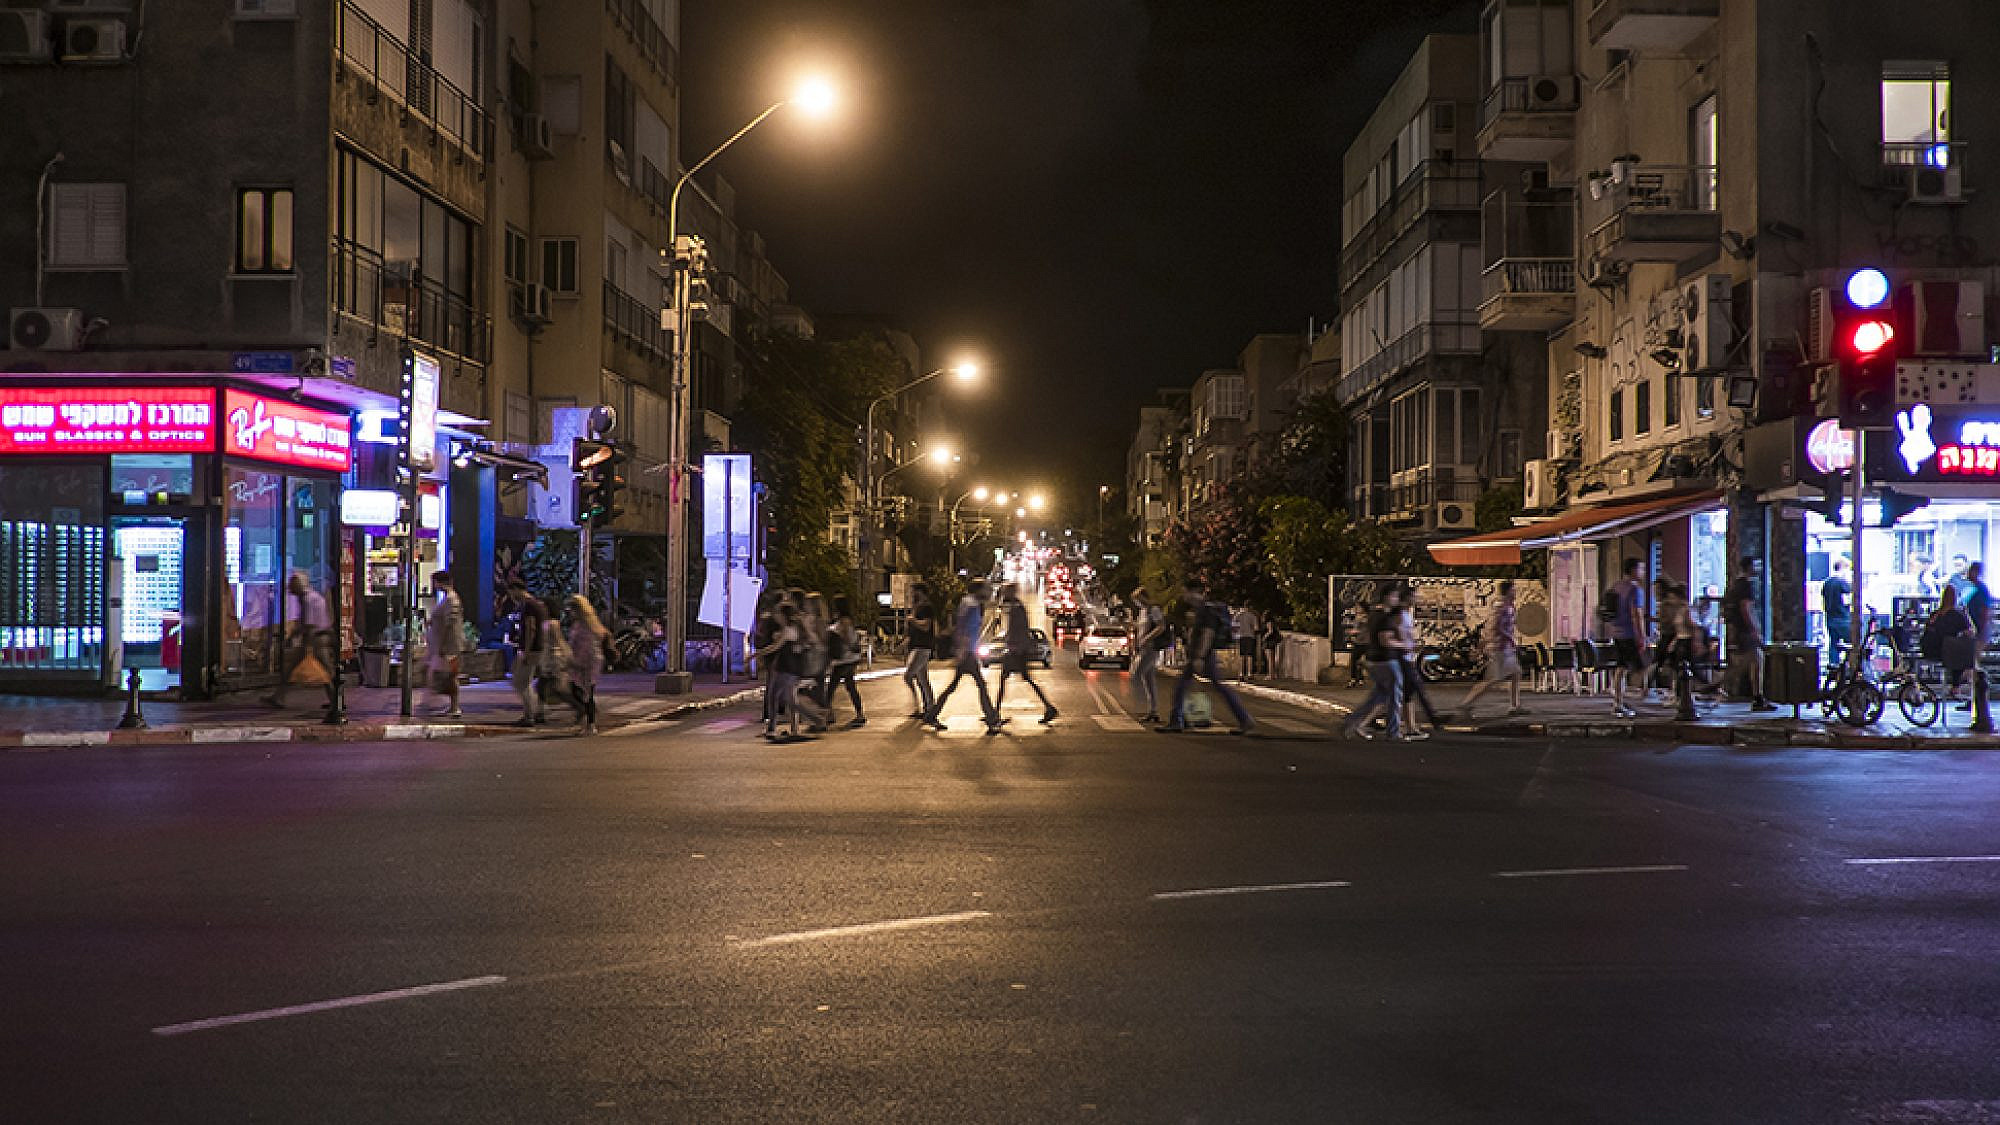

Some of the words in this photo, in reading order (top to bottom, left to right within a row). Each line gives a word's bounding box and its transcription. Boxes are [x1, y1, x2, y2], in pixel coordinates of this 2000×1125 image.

[3, 404, 55, 427] שמש
[60, 402, 142, 428] למשקפי
[148, 403, 210, 425] המרכז
[14, 431, 46, 441] SUN
[54, 431, 125, 441] GLASSES
[130, 430, 143, 441] &
[148, 431, 205, 441] OPTICS
